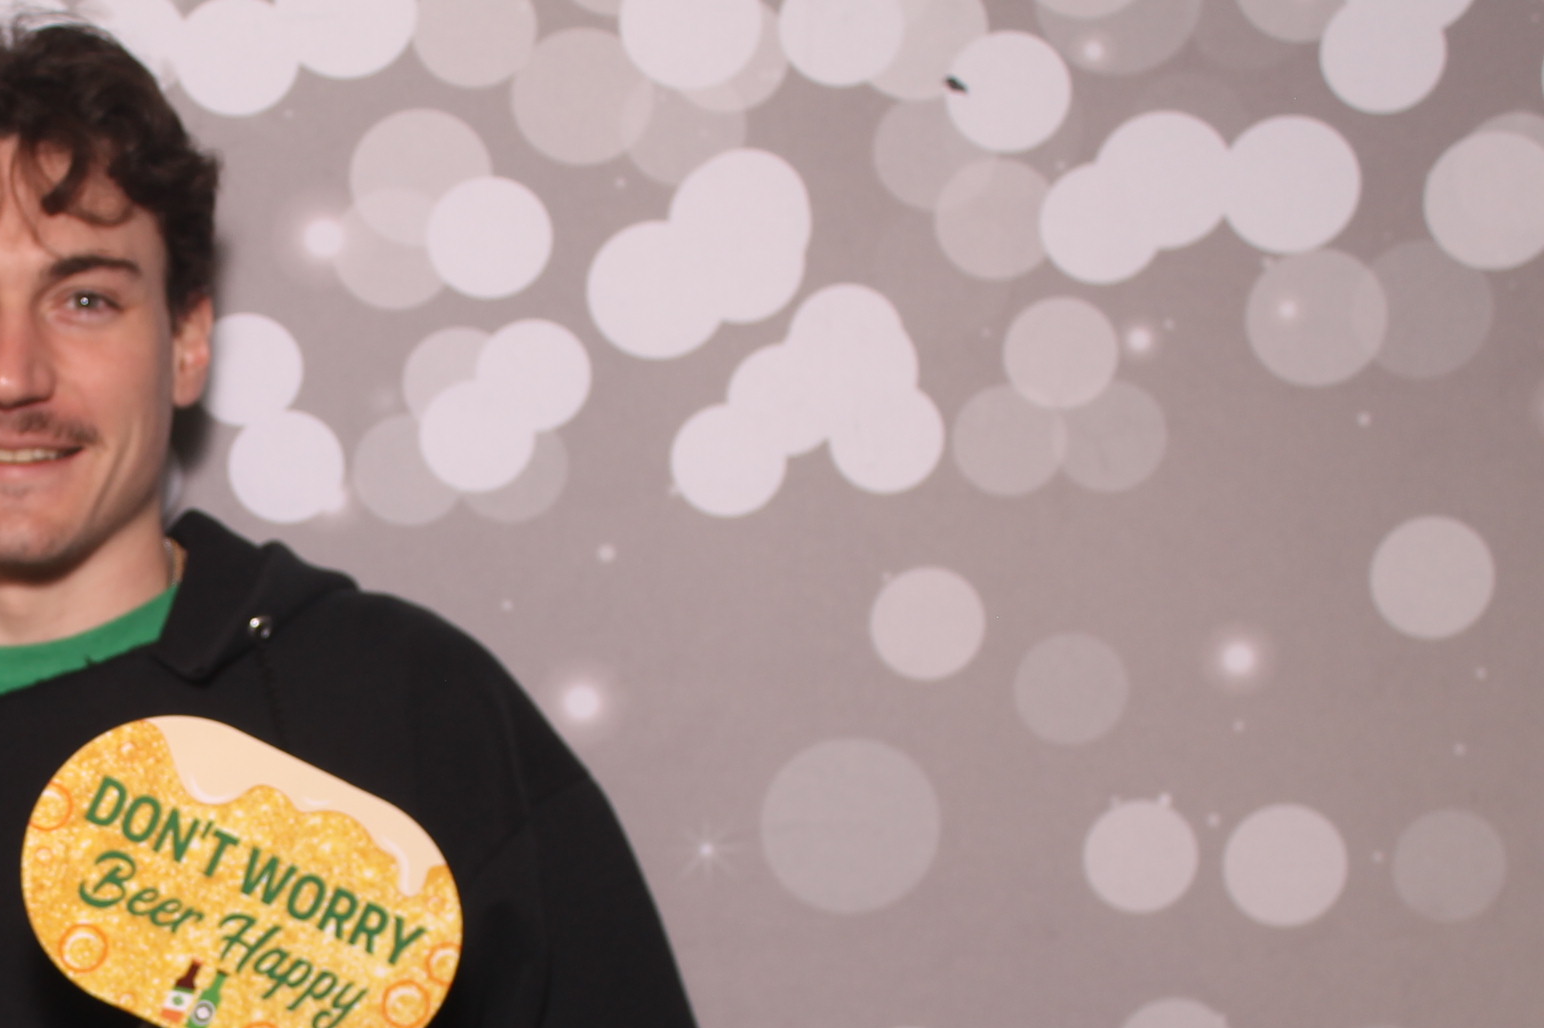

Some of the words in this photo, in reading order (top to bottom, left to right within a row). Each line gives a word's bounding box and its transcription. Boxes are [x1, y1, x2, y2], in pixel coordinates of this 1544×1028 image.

[78, 850, 204, 933] Beer
[84, 775, 240, 879] DON'T
[240, 845, 428, 966] WORRY
